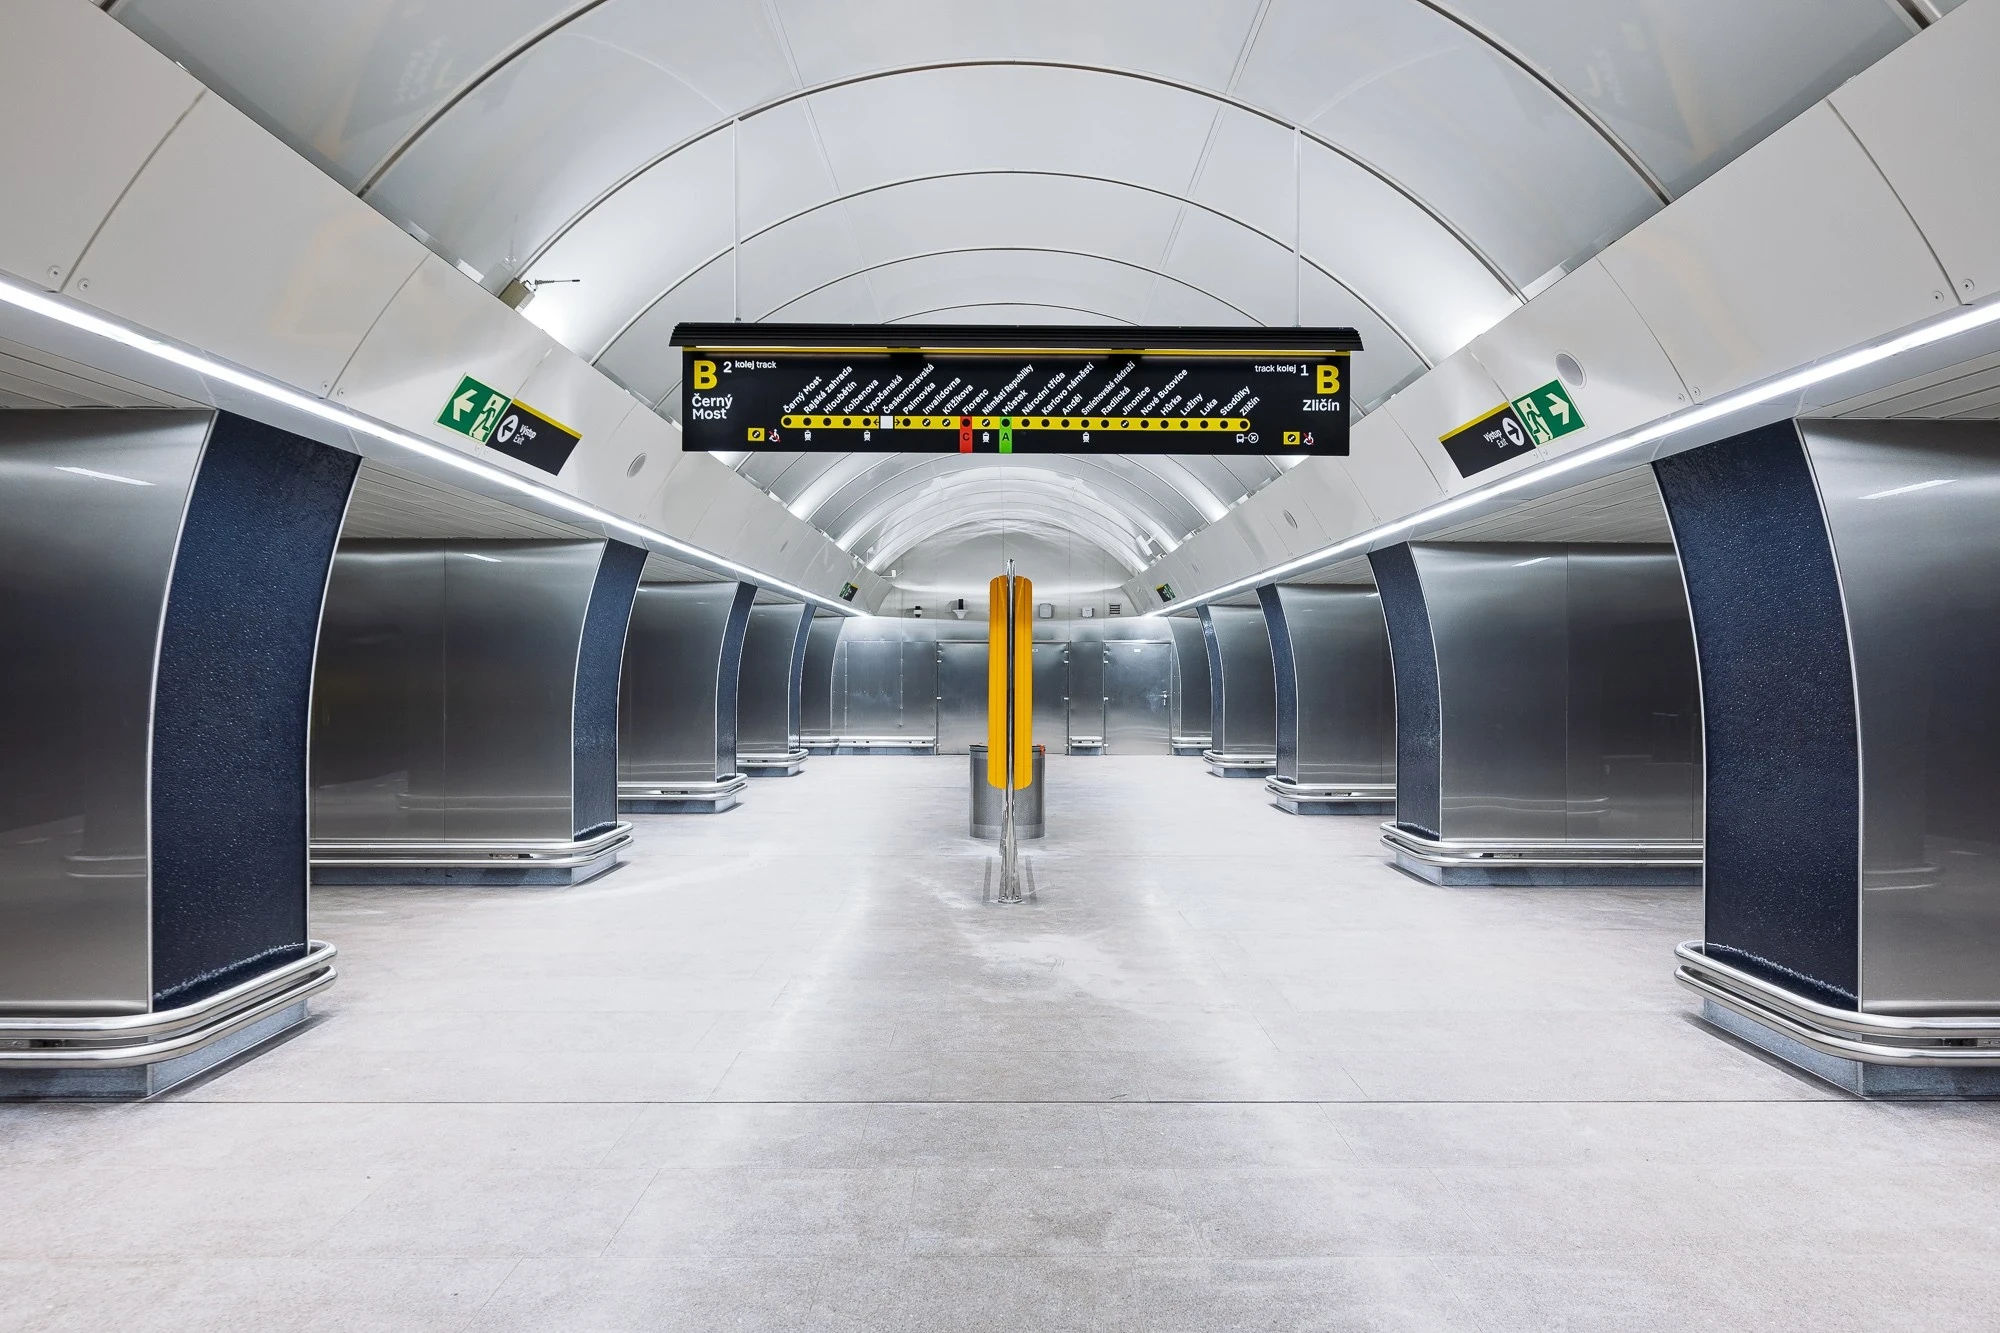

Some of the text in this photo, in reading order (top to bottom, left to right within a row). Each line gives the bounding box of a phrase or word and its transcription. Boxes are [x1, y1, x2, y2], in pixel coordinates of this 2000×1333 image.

[694, 360, 717, 389] B
[723, 360, 777, 373] 2 kolej track
[1277, 364, 1296, 373] kolej
[1300, 364, 1309, 376] 1
[1316, 365, 1340, 394] B
[692, 393, 733, 409] Černý
[783, 376, 822, 413] Černý Most
[803, 366, 852, 414] Rajská zahrada
[823, 381, 858, 414] Hloubětín
[843, 380, 879, 414] Kolbenova
[863, 374, 903, 414] Vysočanská
[882, 363, 934, 414] Českomoravská
[902, 382, 936, 414] Palmovka
[922, 378, 961, 414] Invalidovna
[942, 384, 974, 414] Křižíkova
[962, 389, 988, 415] Florenc
[982, 364, 1034, 415] Náměstí Republiky
[1002, 389, 1028, 415] Můstek
[1022, 372, 1065, 415] Národní třída
[1041, 362, 1094, 415] Karlovo náměstí
[1081, 360, 1135, 415] Smíchovské nádraží
[1101, 386, 1131, 415] Radlická
[1123, 386, 1150, 416] Jinonice
[1141, 369, 1188, 416] Nové Butovice
[1220, 386, 1250, 416] Stodůlky
[692, 408, 727, 420] Most
[1062, 393, 1083, 415] Anděl
[1160, 395, 1182, 416] Hůrka
[1180, 393, 1203, 416] Lužiny
[1200, 399, 1218, 416] Luka
[1239, 396, 1260, 416] Zličín
[1302, 399, 1340, 411] Zličín
[962, 432, 970, 441] C
[1002, 432, 1010, 441] A
